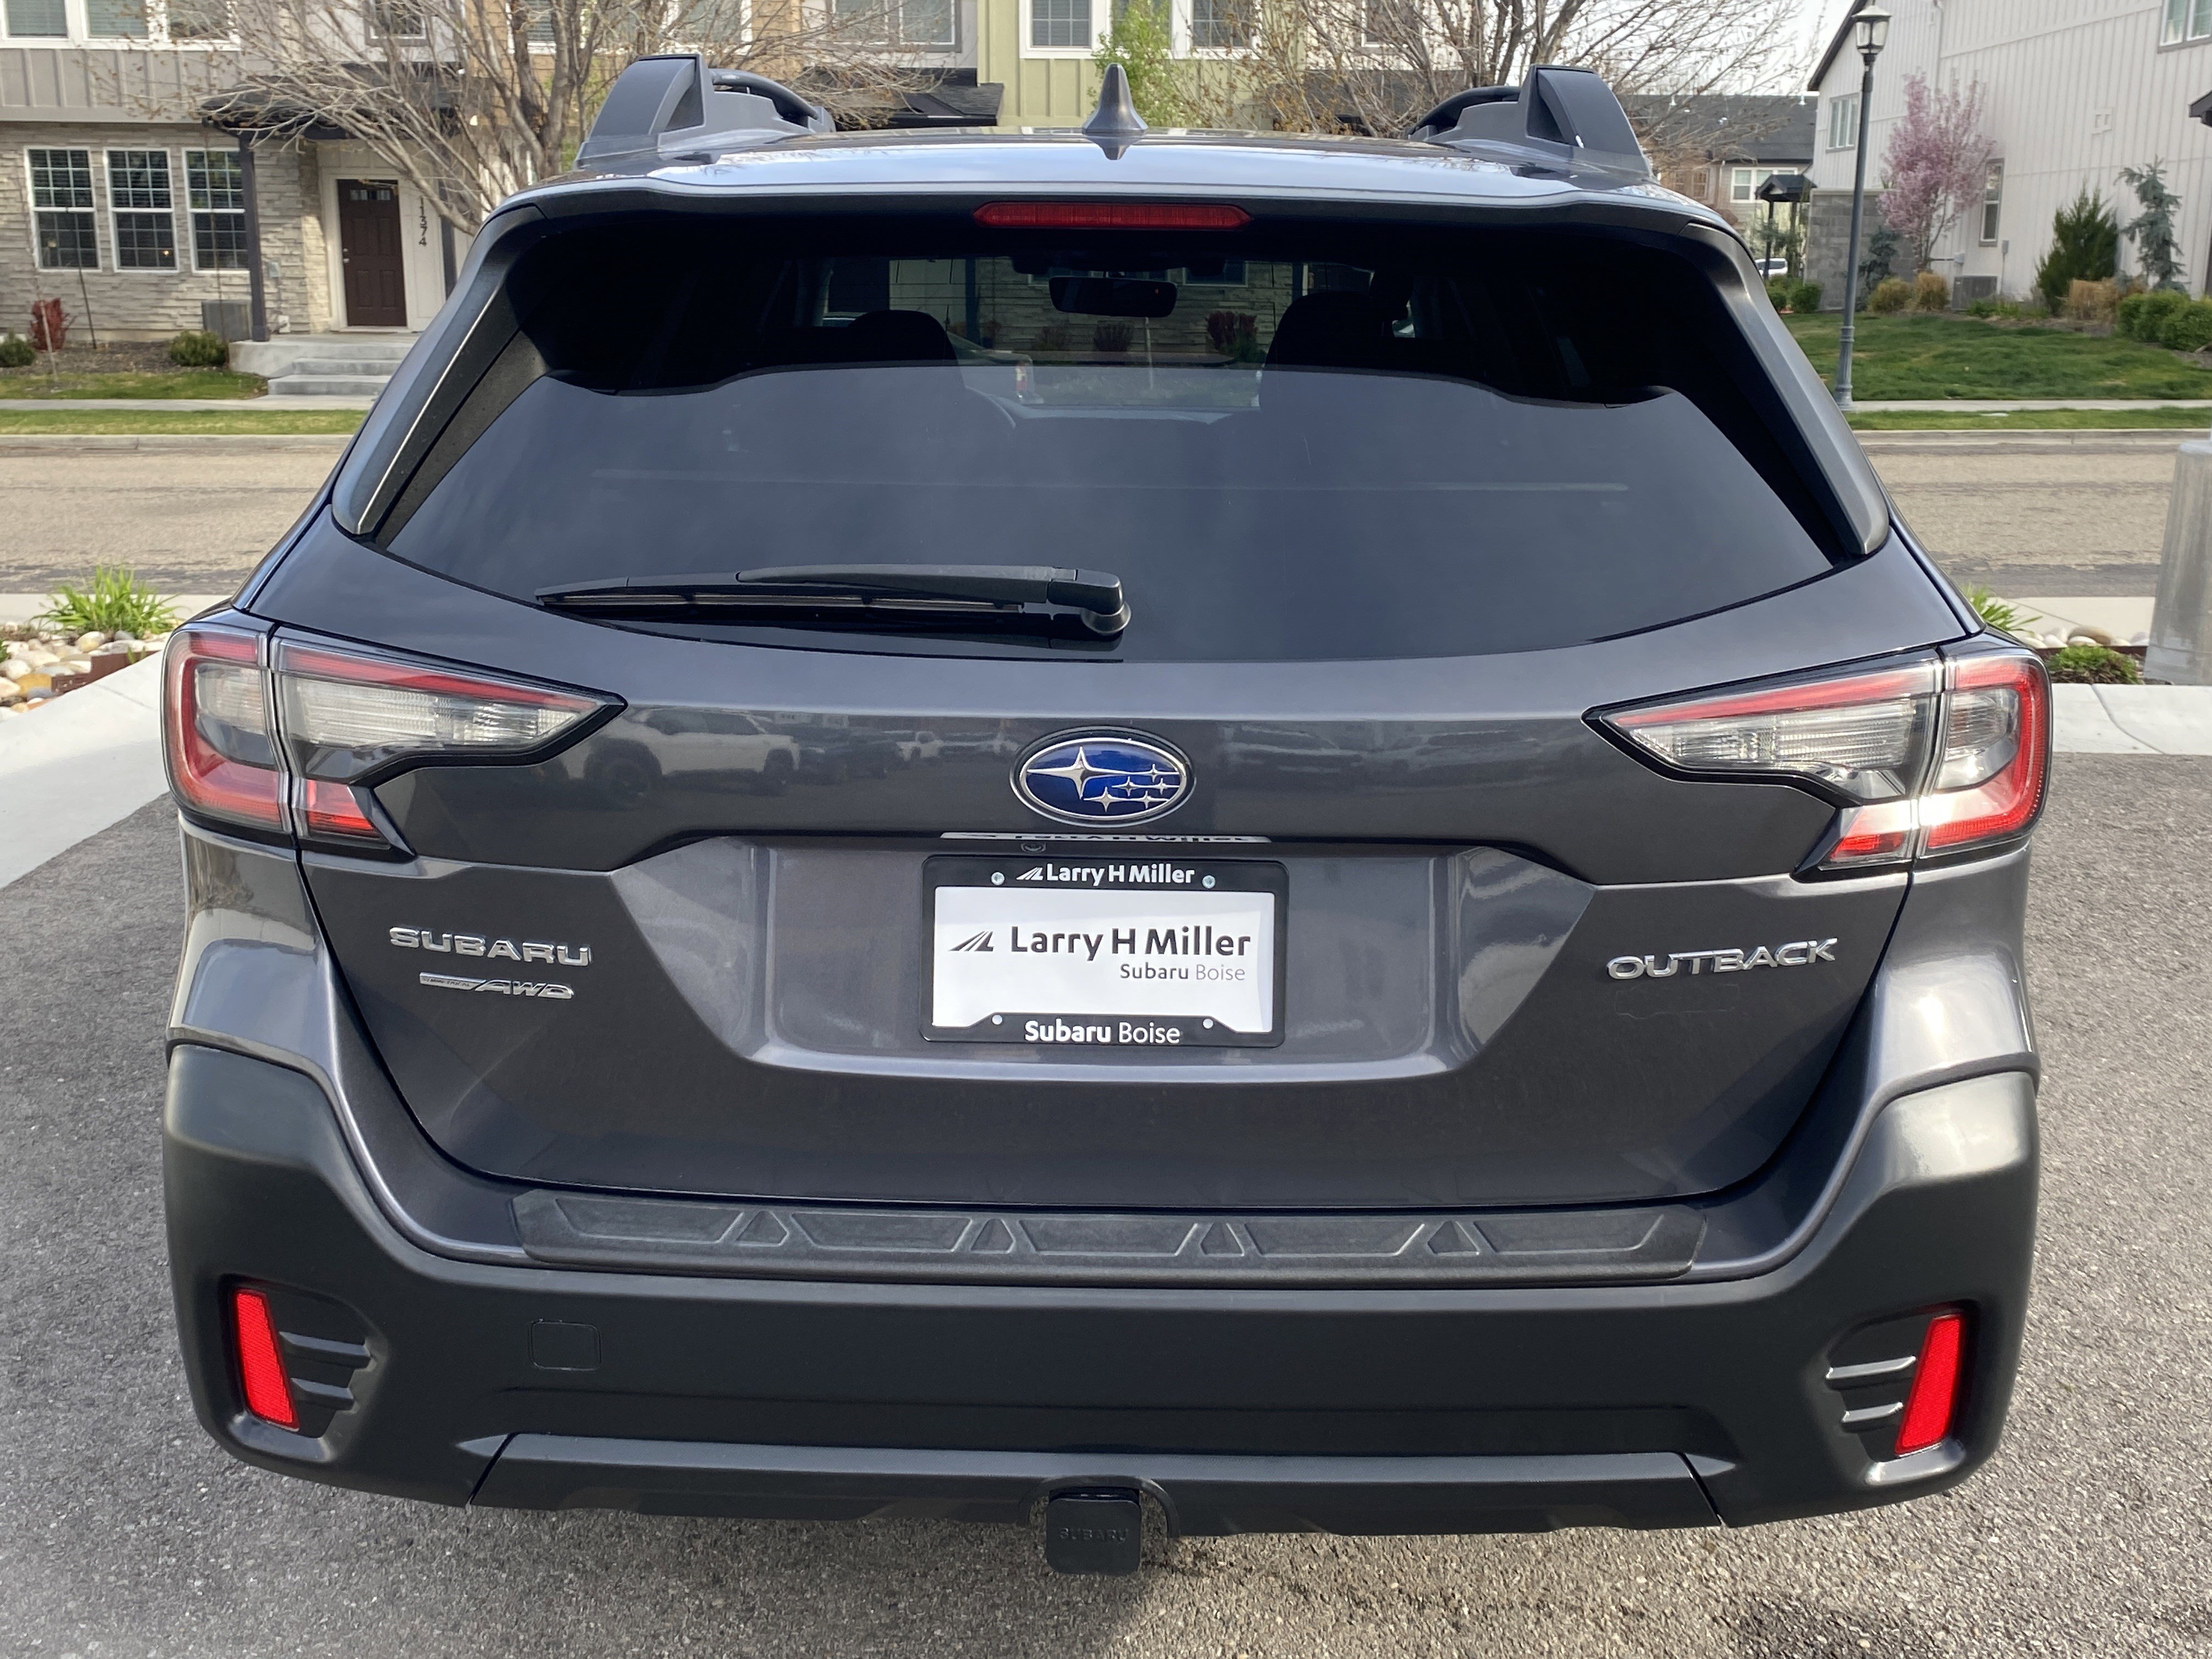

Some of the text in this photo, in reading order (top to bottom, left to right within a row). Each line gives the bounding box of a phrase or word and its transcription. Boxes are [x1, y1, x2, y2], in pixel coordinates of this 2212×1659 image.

[1047, 864, 1195, 886] Larry H Miller
[389, 926, 592, 967] SUBARU
[1011, 926, 1251, 961] Larry H Miller
[1120, 962, 1245, 981] Subaru Boise
[1606, 938, 1838, 980] OUTBACK
[475, 979, 575, 999] AWD
[1025, 1018, 1180, 1044] Subaru Boise
